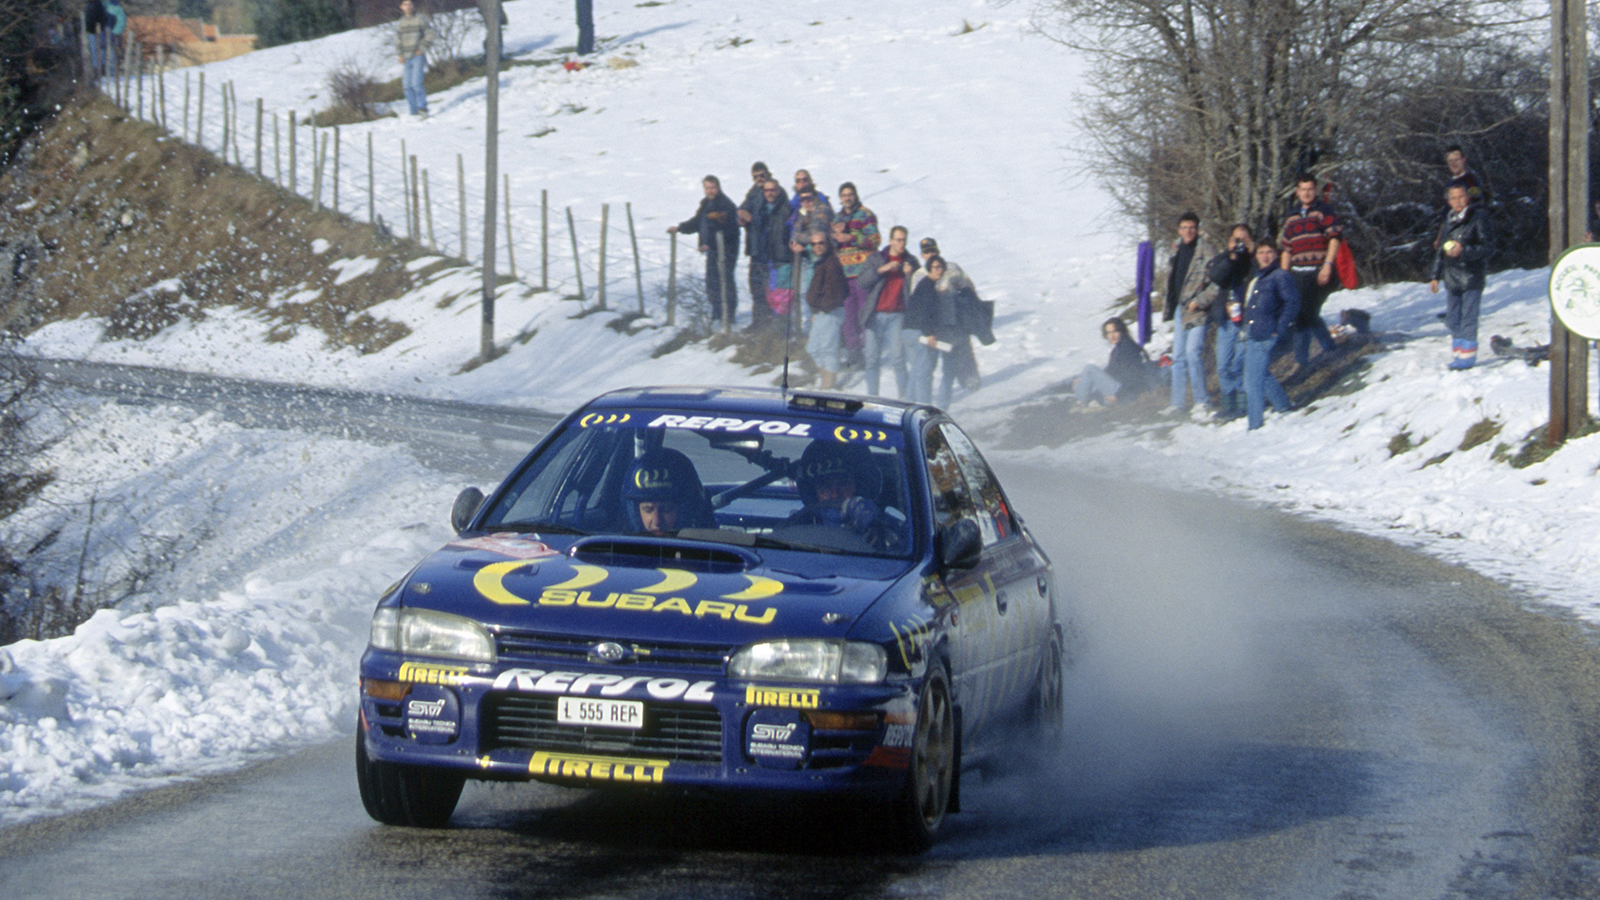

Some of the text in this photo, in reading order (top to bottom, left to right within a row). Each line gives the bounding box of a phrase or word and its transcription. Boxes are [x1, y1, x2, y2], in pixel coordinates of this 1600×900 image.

[648, 414, 812, 436] REPSOL
[538, 590, 777, 624] SUBARU
[398, 661, 469, 686] PIRELLI
[492, 668, 716, 701] REPSOL
[746, 685, 820, 708] PIRELLI
[580, 702, 603, 721] 555
[529, 751, 670, 782] PIRELLI
